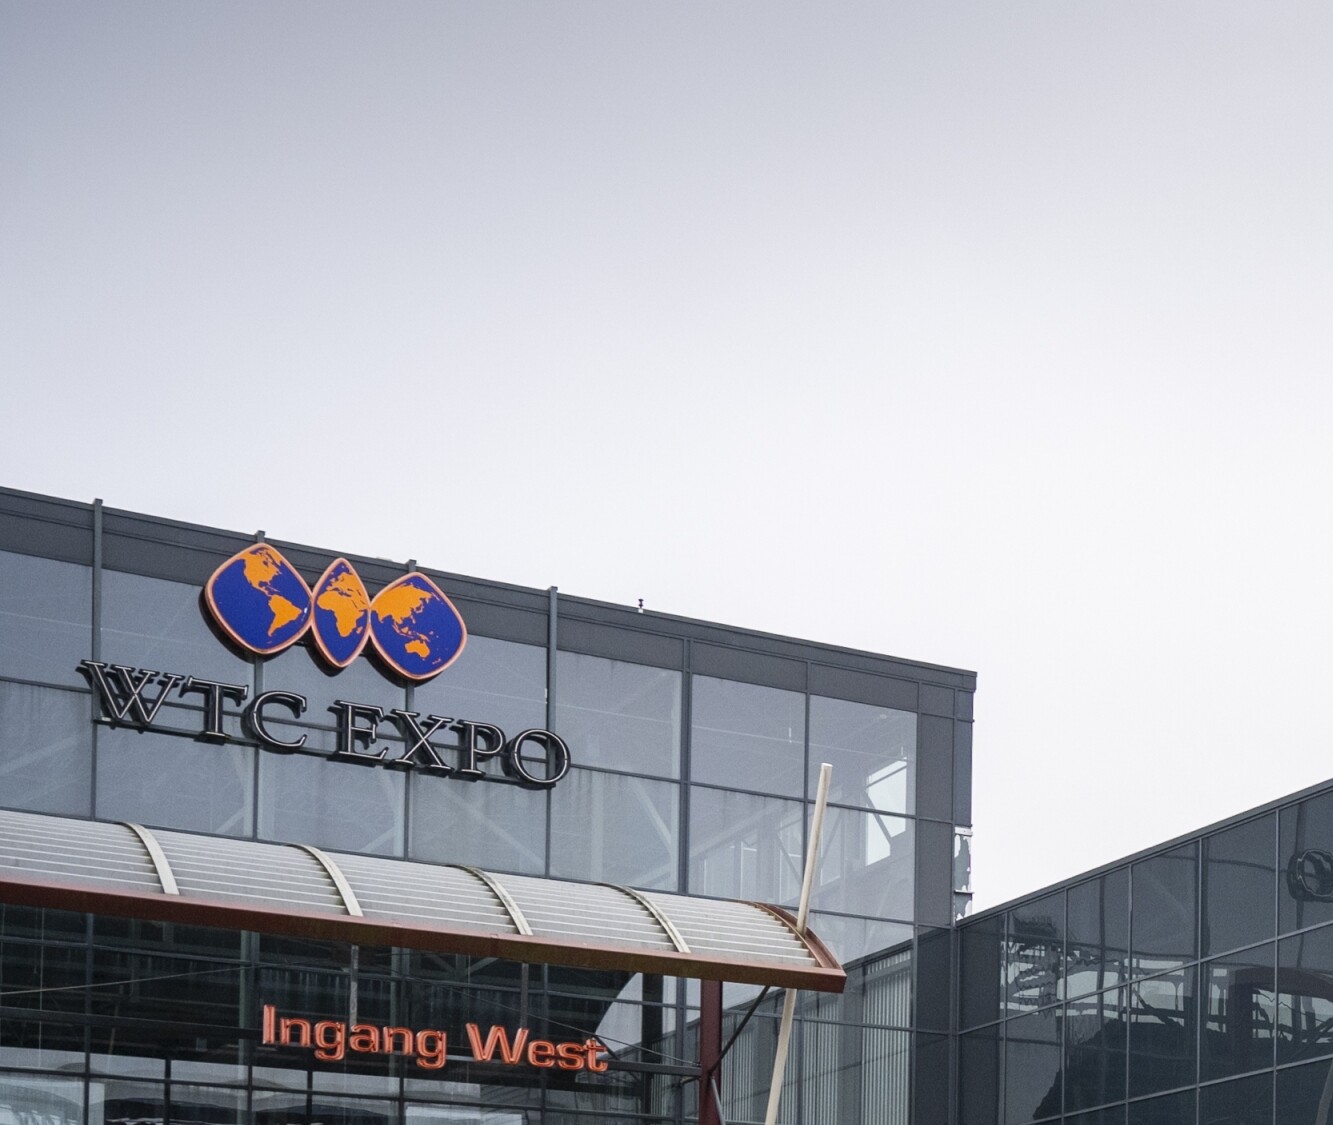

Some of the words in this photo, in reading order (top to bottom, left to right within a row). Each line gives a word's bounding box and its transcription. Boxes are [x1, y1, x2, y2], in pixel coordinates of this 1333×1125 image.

[75, 659, 307, 748] WTC
[327, 700, 572, 788] EXPO
[262, 1003, 447, 1070] Ingang
[465, 1022, 609, 1072] West
